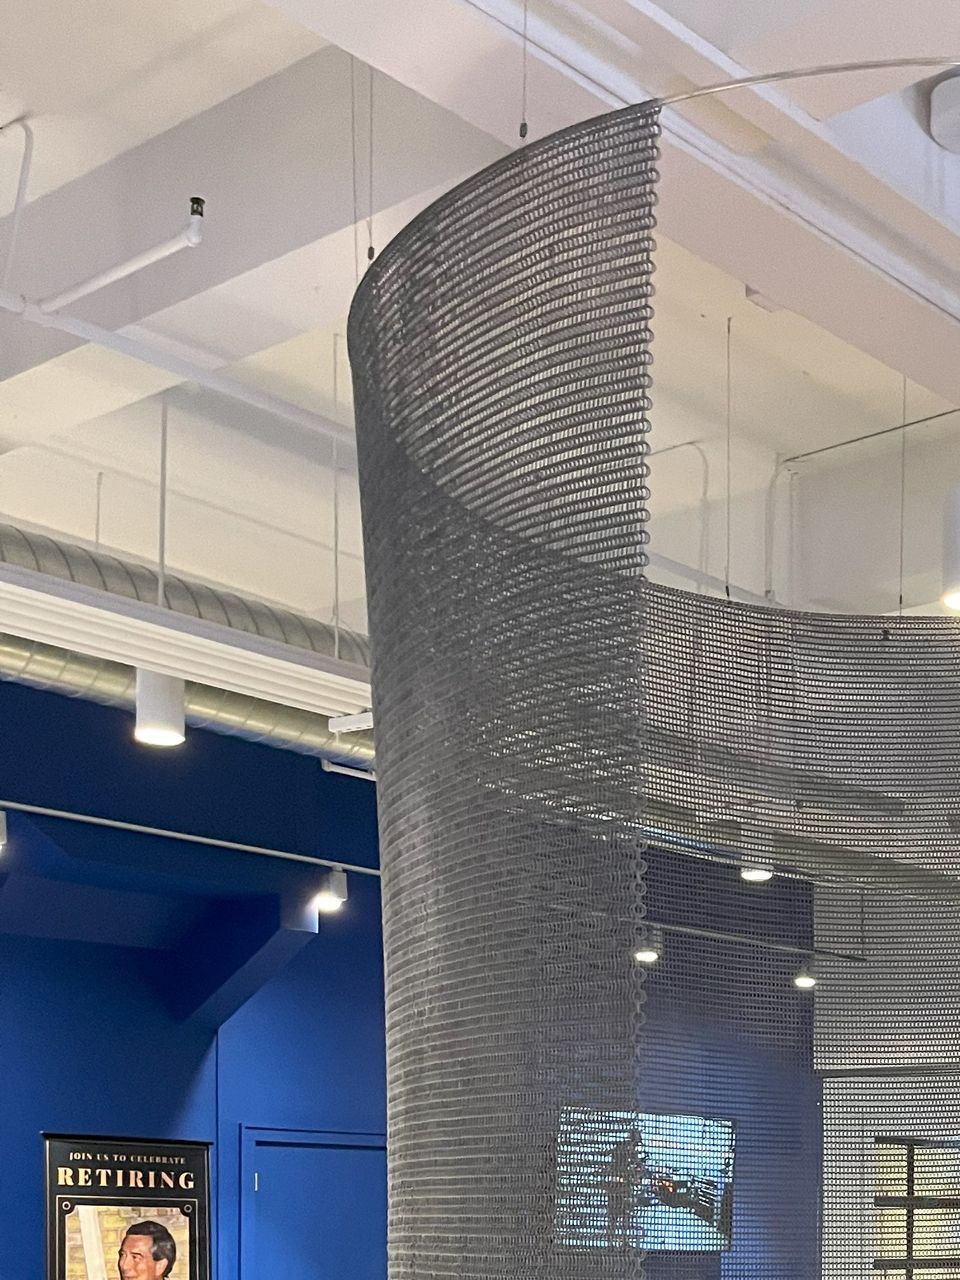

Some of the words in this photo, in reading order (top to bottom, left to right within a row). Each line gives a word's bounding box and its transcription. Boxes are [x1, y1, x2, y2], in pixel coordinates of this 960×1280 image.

[69, 1152, 93, 1161] JOIN
[97, 1153, 109, 1161] US
[113, 1154, 127, 1162] TO
[130, 1155, 186, 1165] CELEBRATE
[57, 1166, 195, 1190] RETIRING
